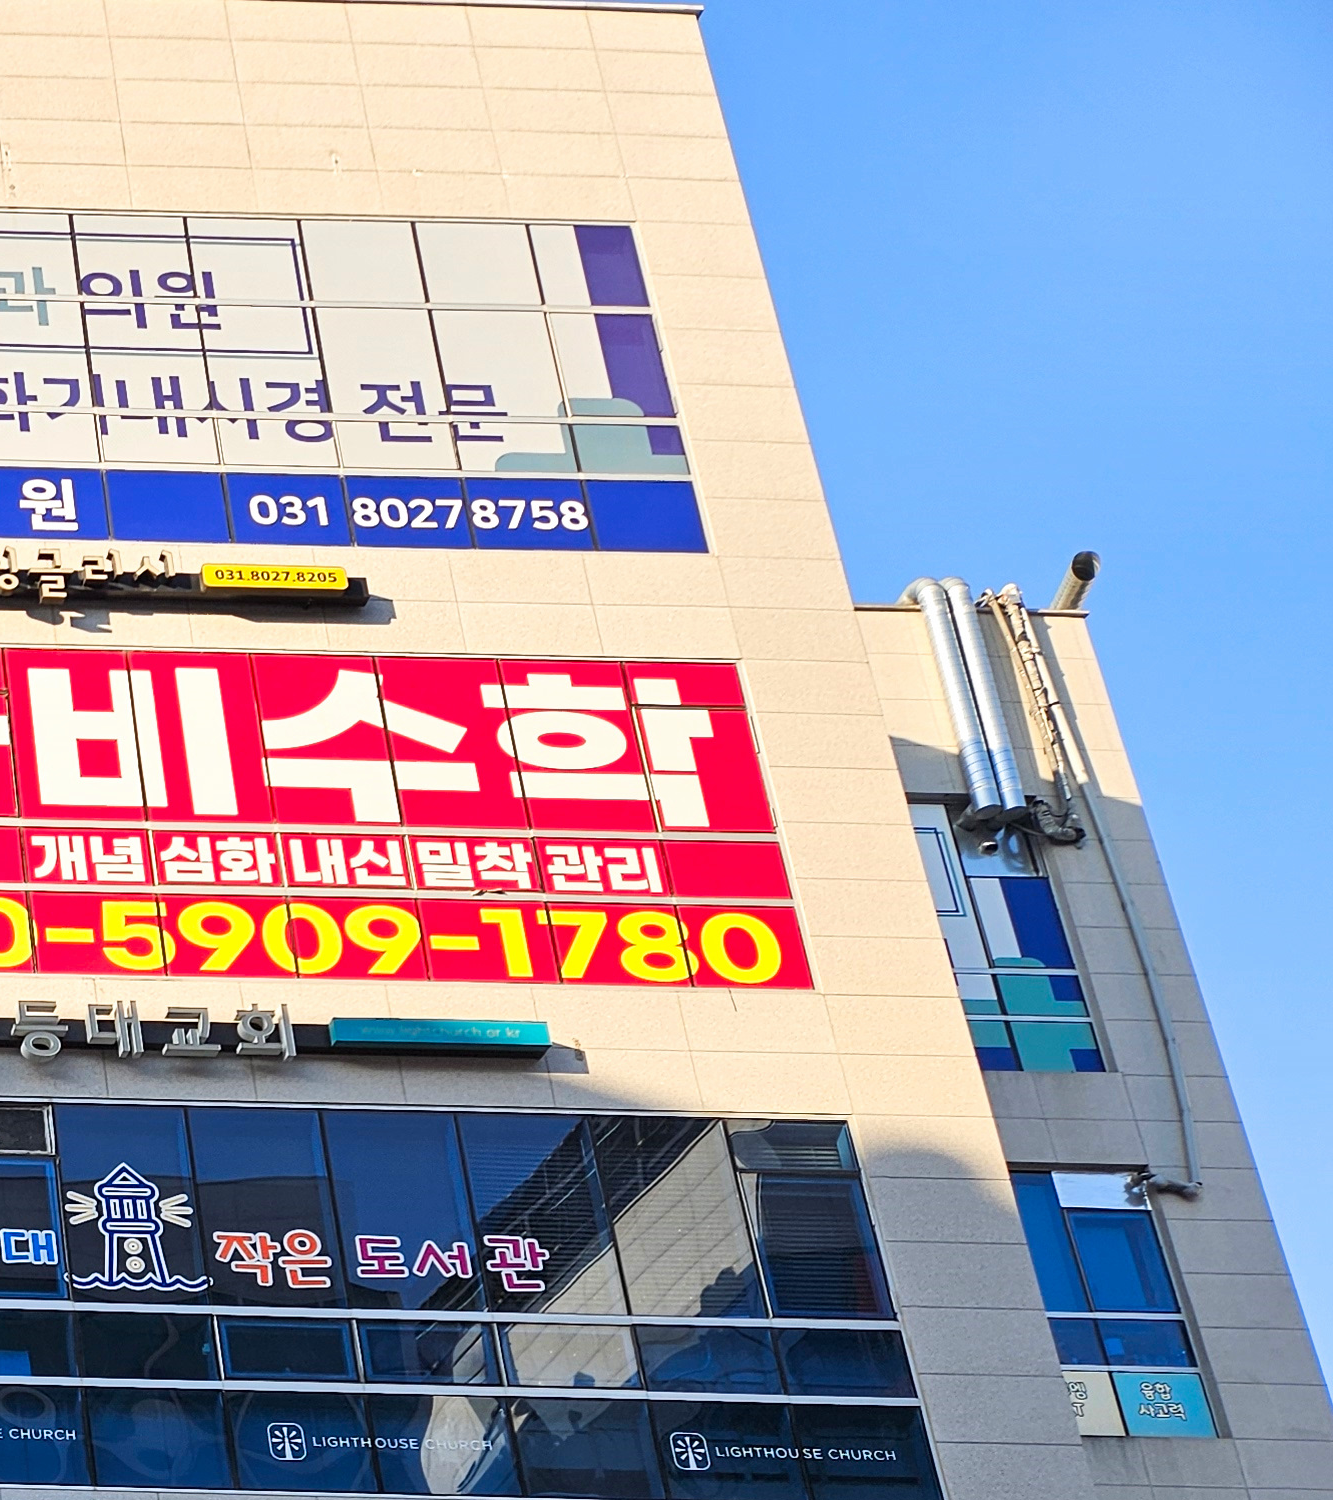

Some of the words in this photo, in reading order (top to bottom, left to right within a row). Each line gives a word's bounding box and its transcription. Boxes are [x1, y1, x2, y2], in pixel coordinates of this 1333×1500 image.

[80, 268, 222, 331] 의원
[360, 380, 508, 443] 전문
[249, 494, 330, 528] 031
[214, 568, 338, 585] 031.8027.8205
[11, 1000, 297, 1063] 등대교회
[213, 1229, 334, 1290] 작은
[354, 1233, 550, 1293] 도서관
[8, 1427, 78, 1442] CHURCH
[425, 1437, 493, 1453] CHURCH
[828, 1447, 897, 1464] CHURCH
